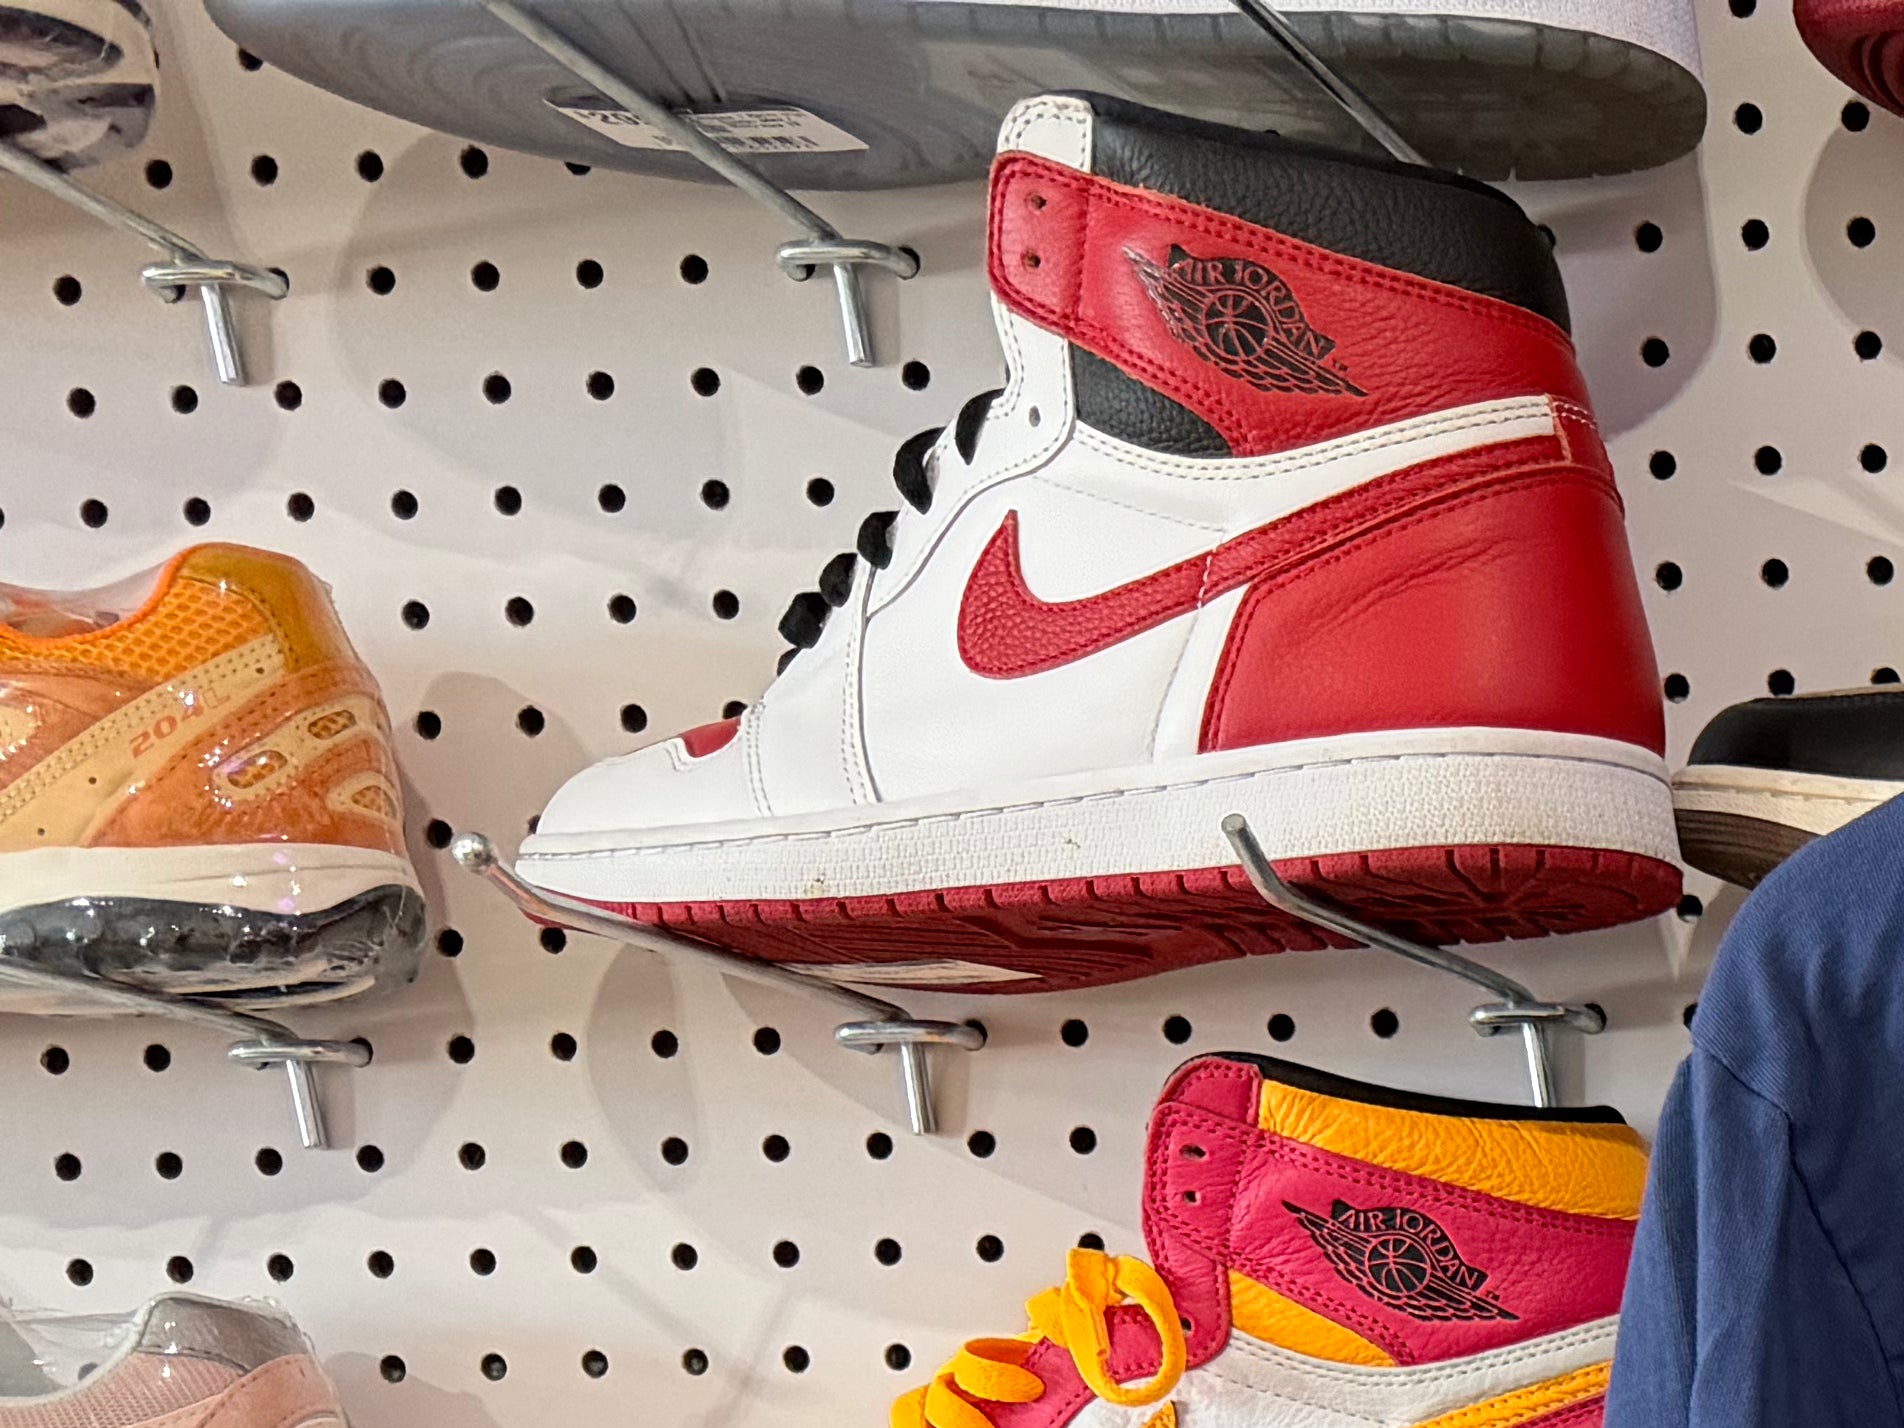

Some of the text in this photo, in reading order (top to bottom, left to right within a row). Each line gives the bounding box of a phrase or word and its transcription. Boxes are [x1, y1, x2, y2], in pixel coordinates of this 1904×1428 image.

[1170, 258, 1326, 360] AIR JORDAN
[1339, 1209, 1387, 1231] AIR
[1396, 1208, 1479, 1289] JORDAN
